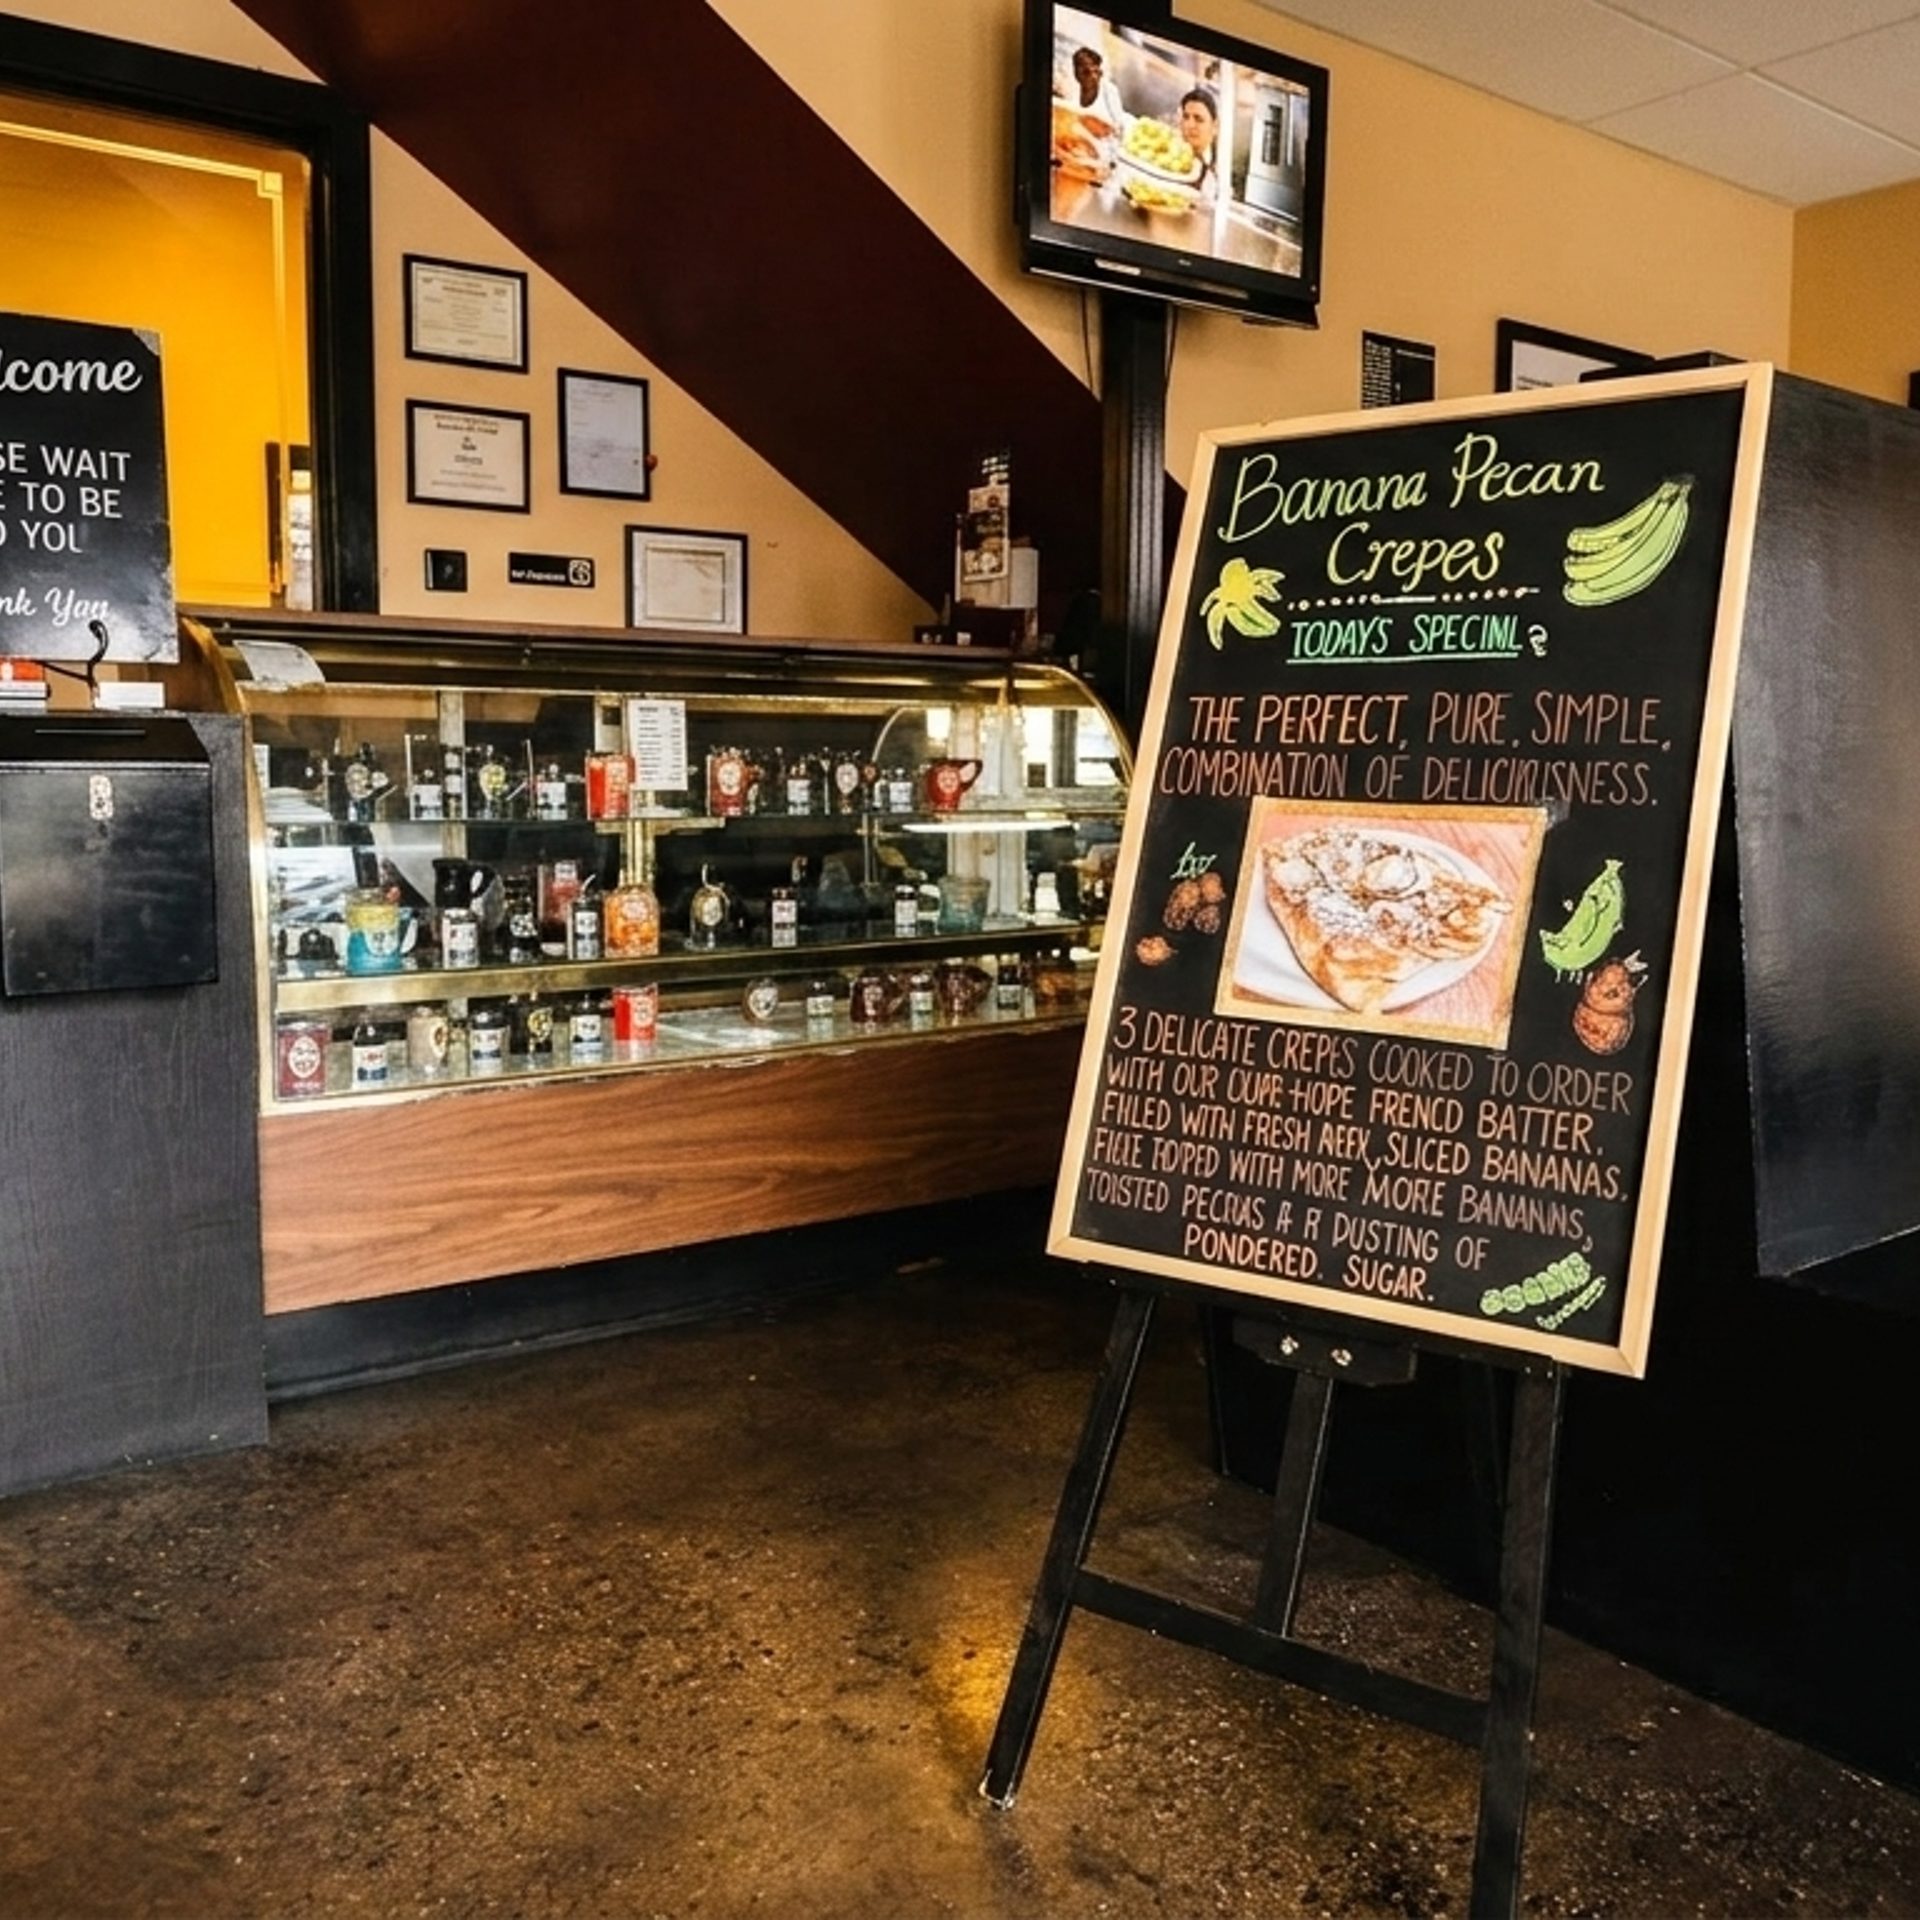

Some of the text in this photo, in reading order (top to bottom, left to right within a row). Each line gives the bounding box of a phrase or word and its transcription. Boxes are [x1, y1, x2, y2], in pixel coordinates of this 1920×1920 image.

[40, 444, 131, 482] WAIT
[1217, 432, 1605, 543] Banana Pecan
[18, 481, 66, 514] TO
[79, 486, 123, 518] BE
[1327, 522, 1504, 593] Crepes
[1189, 695, 1245, 744] THE
[1160, 746, 1350, 798] COMBINATION
[1365, 754, 1410, 800] OF
[1106, 1054, 1166, 1093] WITH
[1172, 1061, 1220, 1100] OUR
[1113, 1006, 1138, 1050] 3
[1142, 1011, 1261, 1066] DELICATE
[1369, 1038, 1474, 1092] COOKED
[1487, 1054, 1520, 1097] TO
[1527, 1061, 1633, 1116] ORDER
[1242, 1110, 1312, 1153] FRESH
[1384, 1131, 1471, 1176] SLICED
[1228, 1148, 1284, 1191] WITH
[1292, 1158, 1353, 1202] MORE
[1362, 1172, 1446, 1217] MORE
[1332, 1211, 1440, 1263] DUSTING
[1455, 1236, 1490, 1271] OF
[1341, 1254, 1435, 1303] SUGAR.
